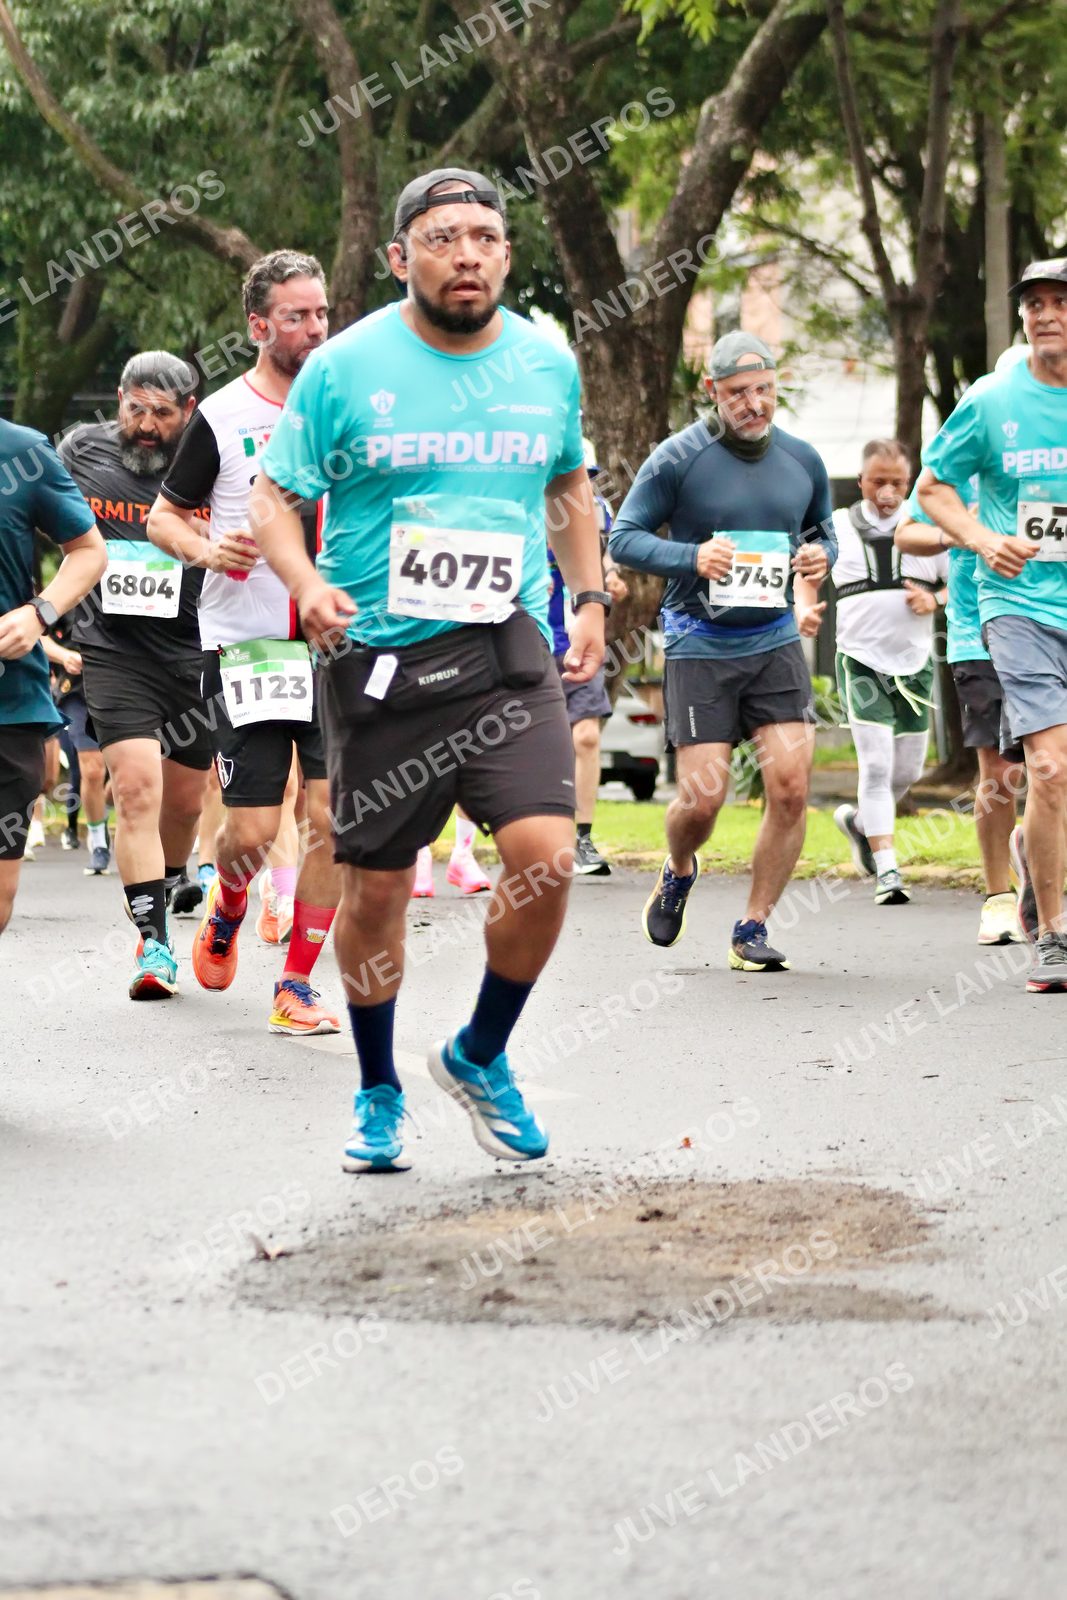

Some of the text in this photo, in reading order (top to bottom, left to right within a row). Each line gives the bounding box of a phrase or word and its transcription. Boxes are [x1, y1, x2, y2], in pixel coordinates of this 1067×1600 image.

[367, 431, 548, 468] PERDURA
[1025, 516, 1067, 541] 64
[400, 548, 513, 594] 4075
[106, 573, 175, 600] 6804
[230, 674, 308, 706] 1123
[418, 667, 459, 687] KIPRUN
